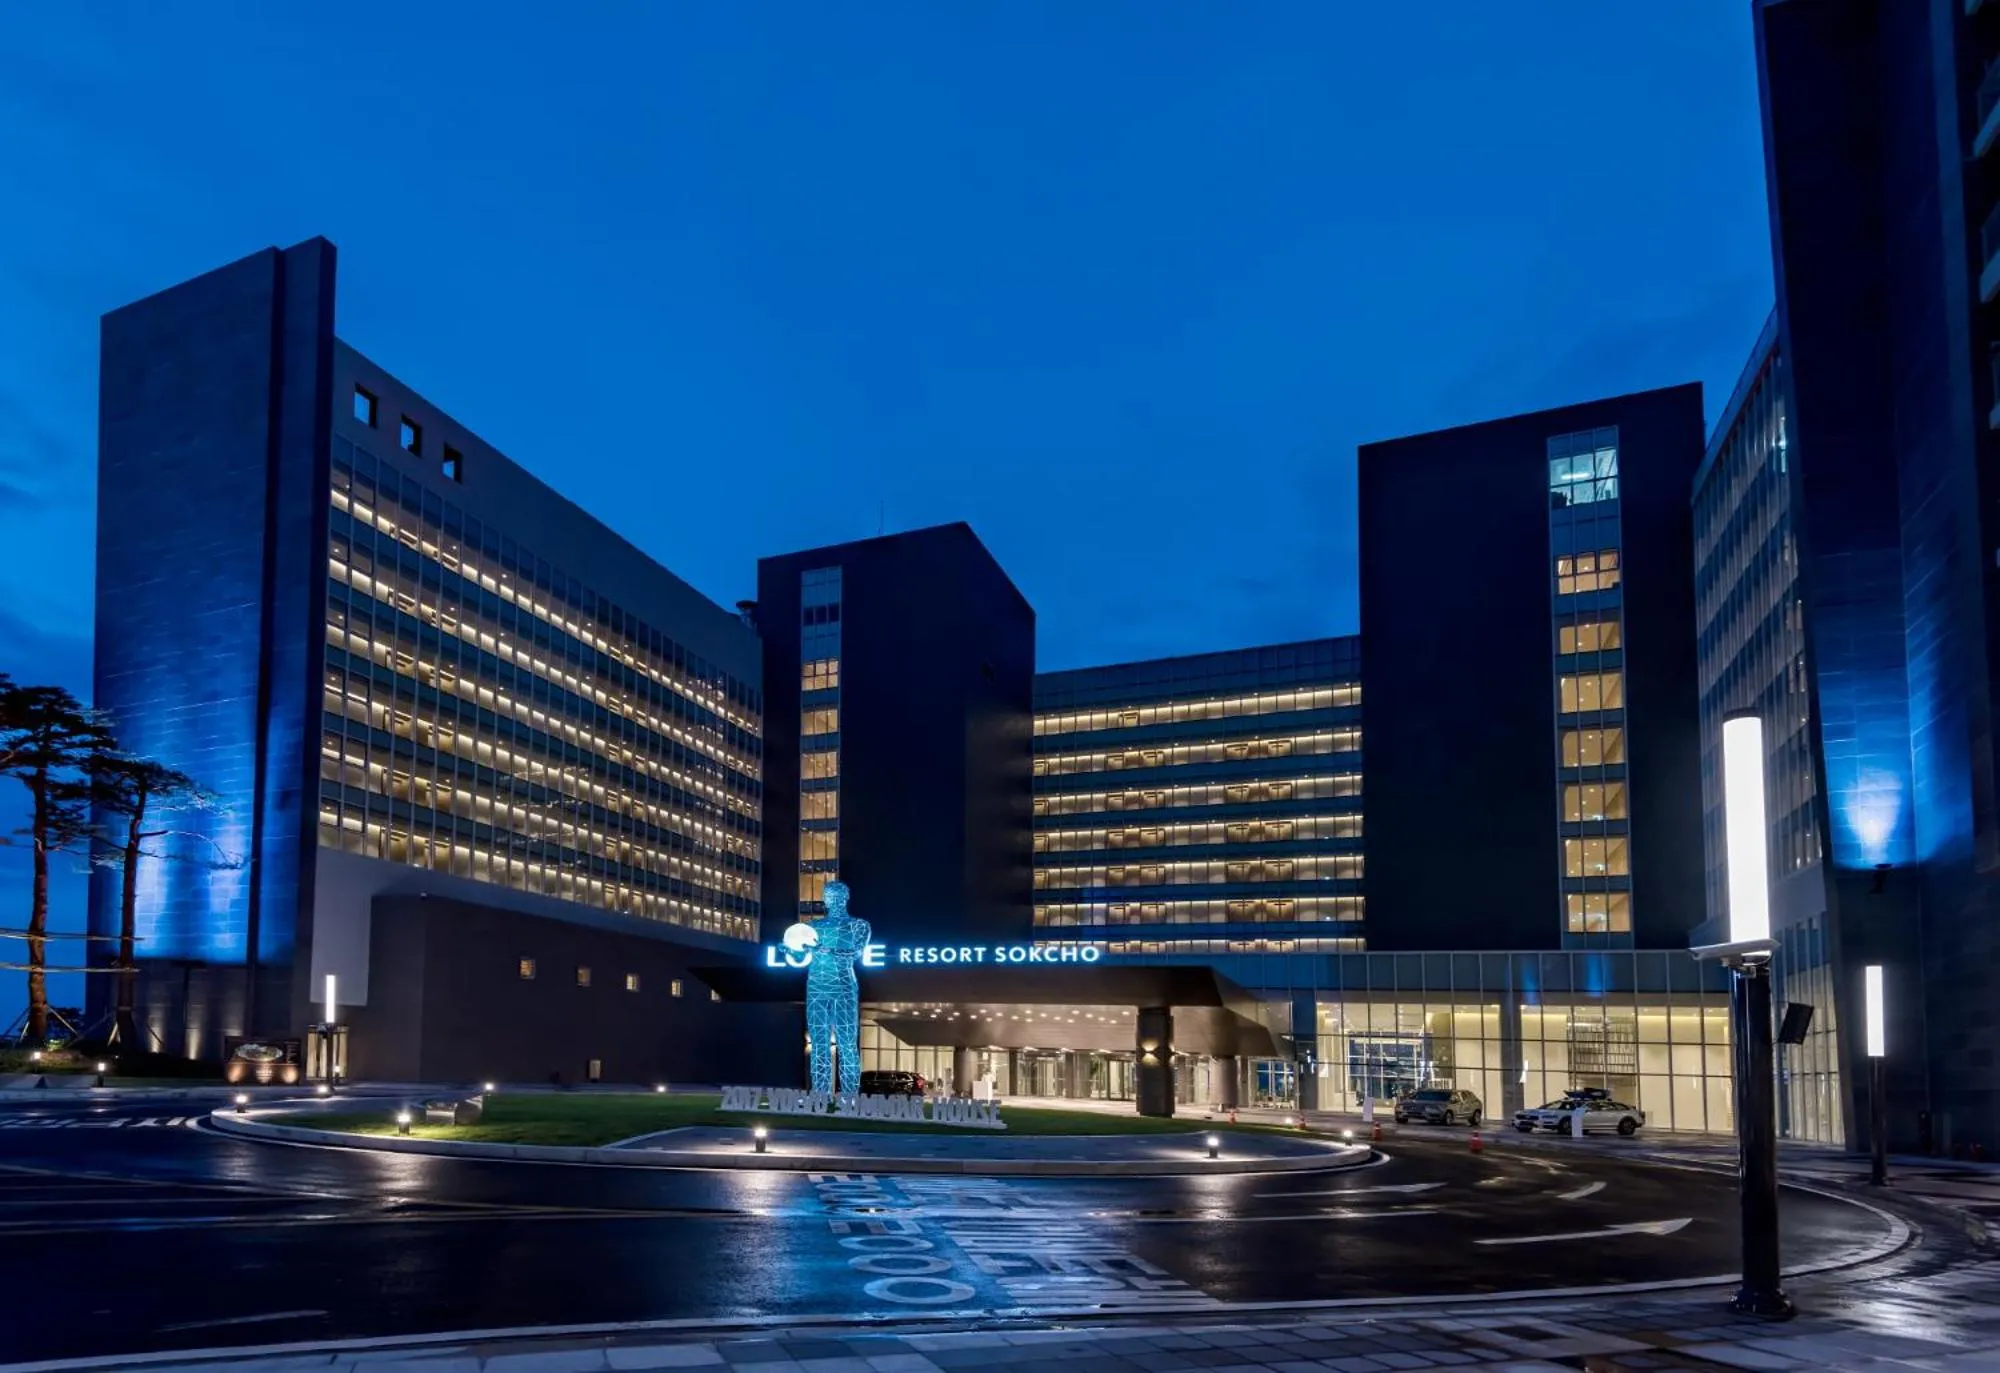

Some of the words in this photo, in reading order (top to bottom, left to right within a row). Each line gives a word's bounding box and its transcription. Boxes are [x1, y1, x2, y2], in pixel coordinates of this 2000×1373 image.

[767, 944, 886, 968] LOE
[900, 946, 986, 963] RESORT
[994, 945, 1100, 963] SOKCHO
[933, 1096, 1001, 1122] HOUSE
